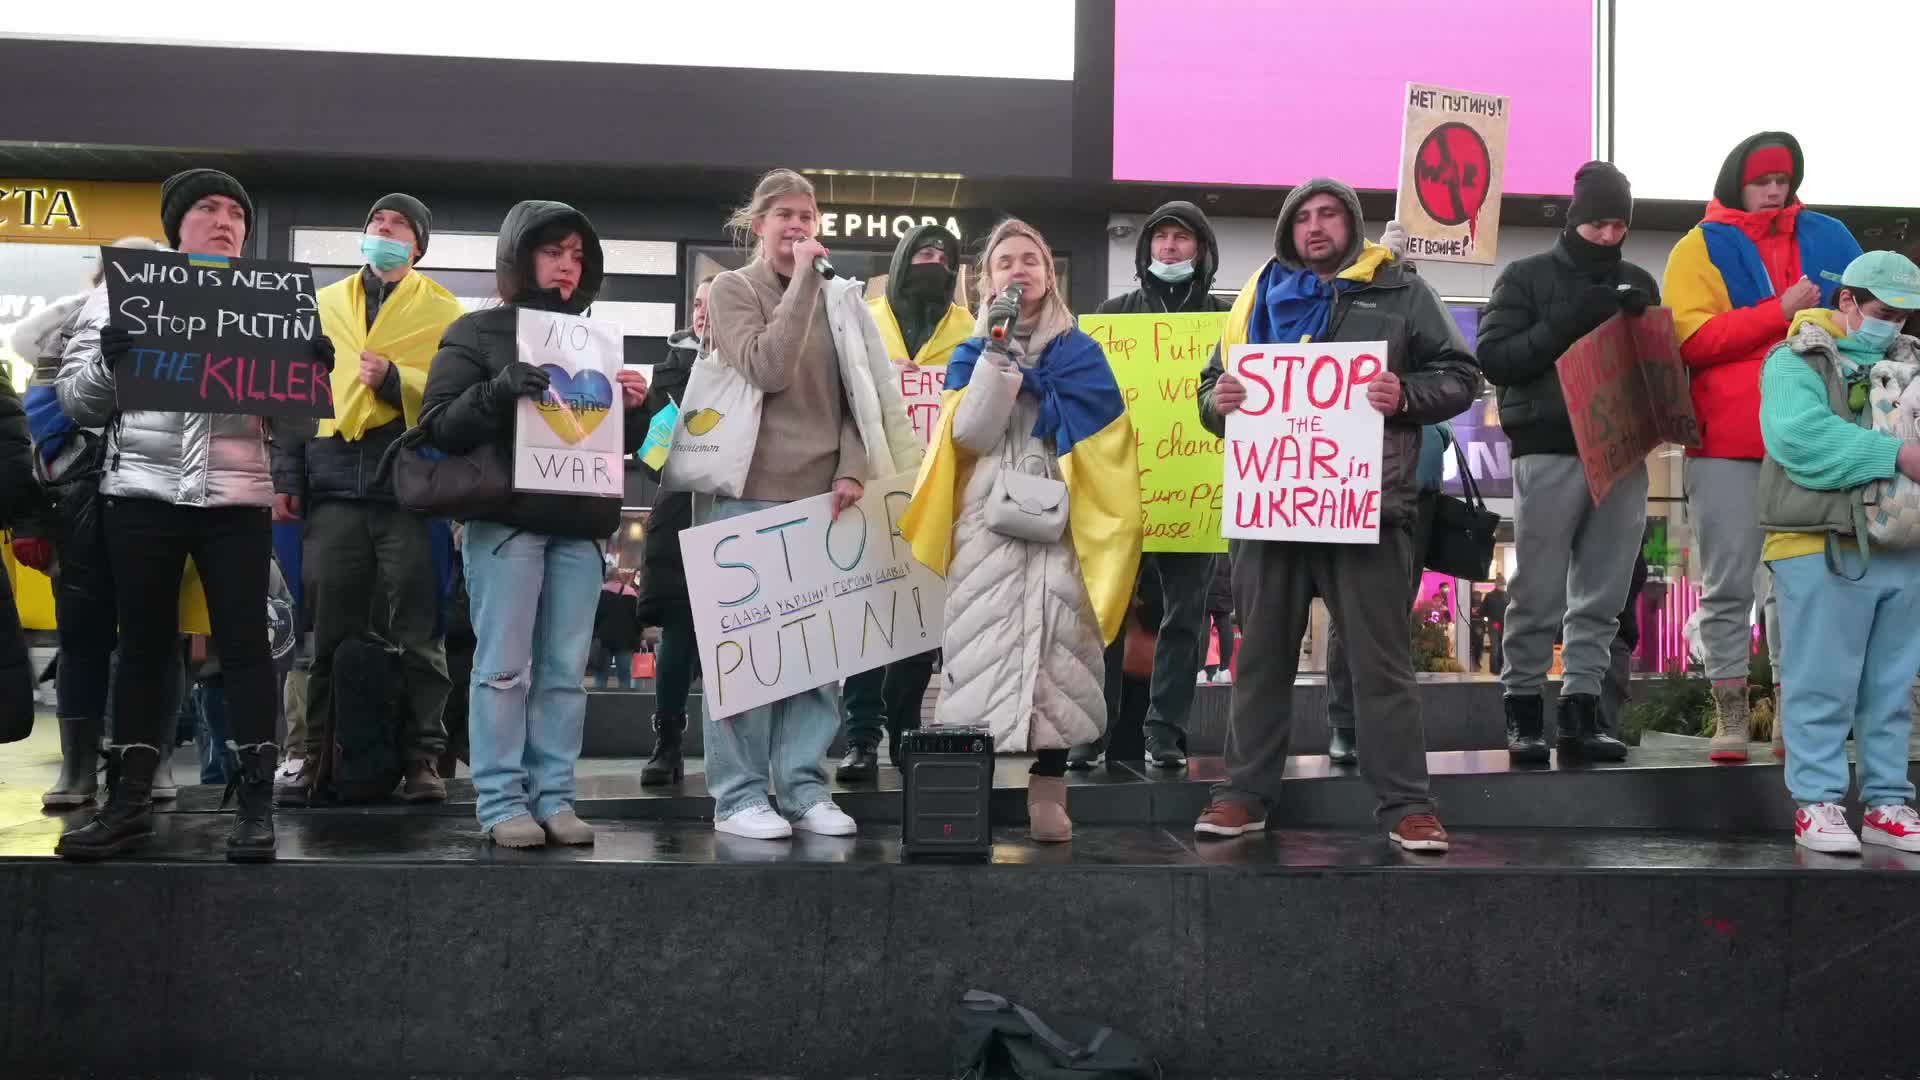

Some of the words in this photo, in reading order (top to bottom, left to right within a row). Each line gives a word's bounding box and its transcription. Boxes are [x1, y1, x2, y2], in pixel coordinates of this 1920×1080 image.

[1409, 89, 1436, 110] НЕТ
[1441, 94, 1503, 117] ПУТИНУ!
[0, 187, 81, 228] TA
[816, 213, 962, 240] EPHOA
[112, 261, 188, 285] WHO
[198, 269, 224, 287] IS
[544, 320, 589, 351] NO
[132, 347, 198, 383] THE
[200, 351, 333, 404] KILLER
[1237, 352, 1382, 416] STOP
[1287, 415, 1324, 434] THE
[533, 454, 612, 484] WAR
[1232, 434, 1339, 483] WAR
[1347, 456, 1369, 479] in
